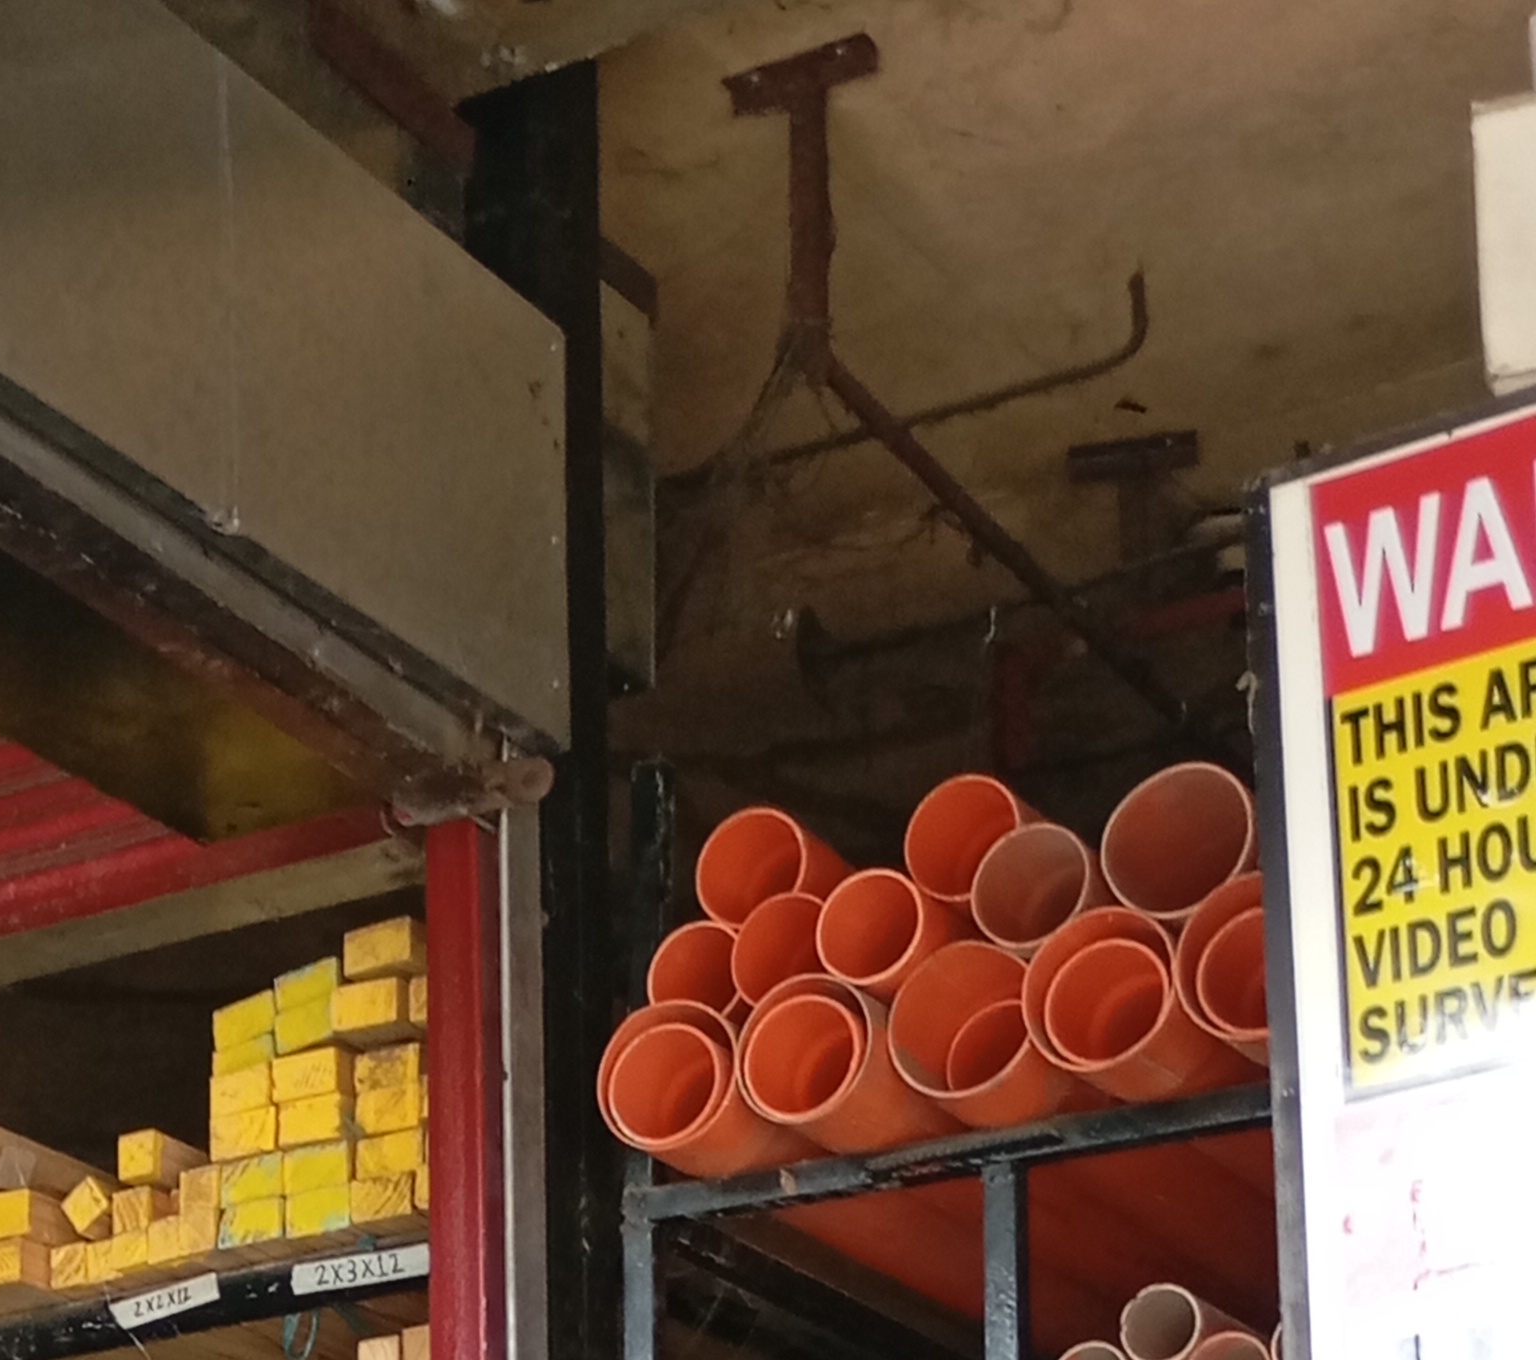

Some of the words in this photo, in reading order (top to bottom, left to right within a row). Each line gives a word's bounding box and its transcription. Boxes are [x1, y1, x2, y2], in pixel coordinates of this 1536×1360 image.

[1323, 466, 1536, 657] WA
[1340, 682, 1462, 766] THIS
[1348, 775, 1397, 842] IS
[1415, 737, 1536, 823] UND
[1351, 843, 1419, 917] 24
[1353, 898, 1517, 990] VIDEO
[315, 1252, 406, 1286] 2X3X12
